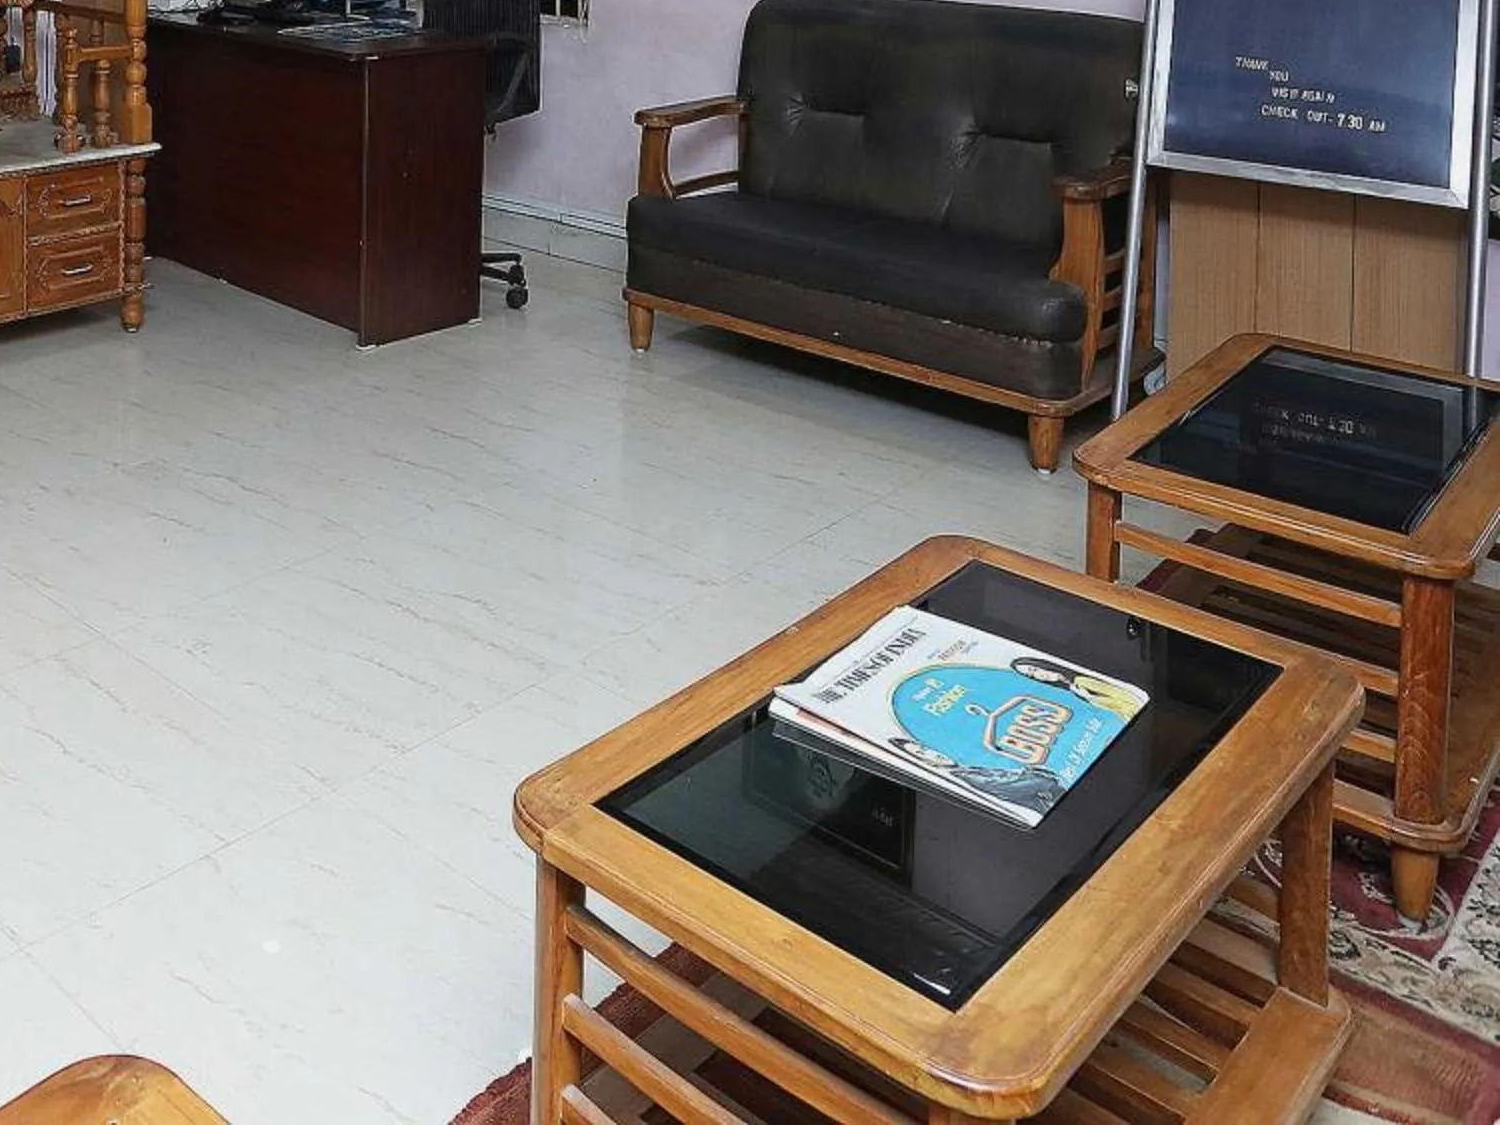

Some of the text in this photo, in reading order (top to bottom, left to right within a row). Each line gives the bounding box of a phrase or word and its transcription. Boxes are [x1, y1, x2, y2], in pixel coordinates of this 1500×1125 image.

[1235, 56, 1269, 72] THANK
[1269, 70, 1289, 82] YOU
[1261, 103, 1300, 120] CHECK
